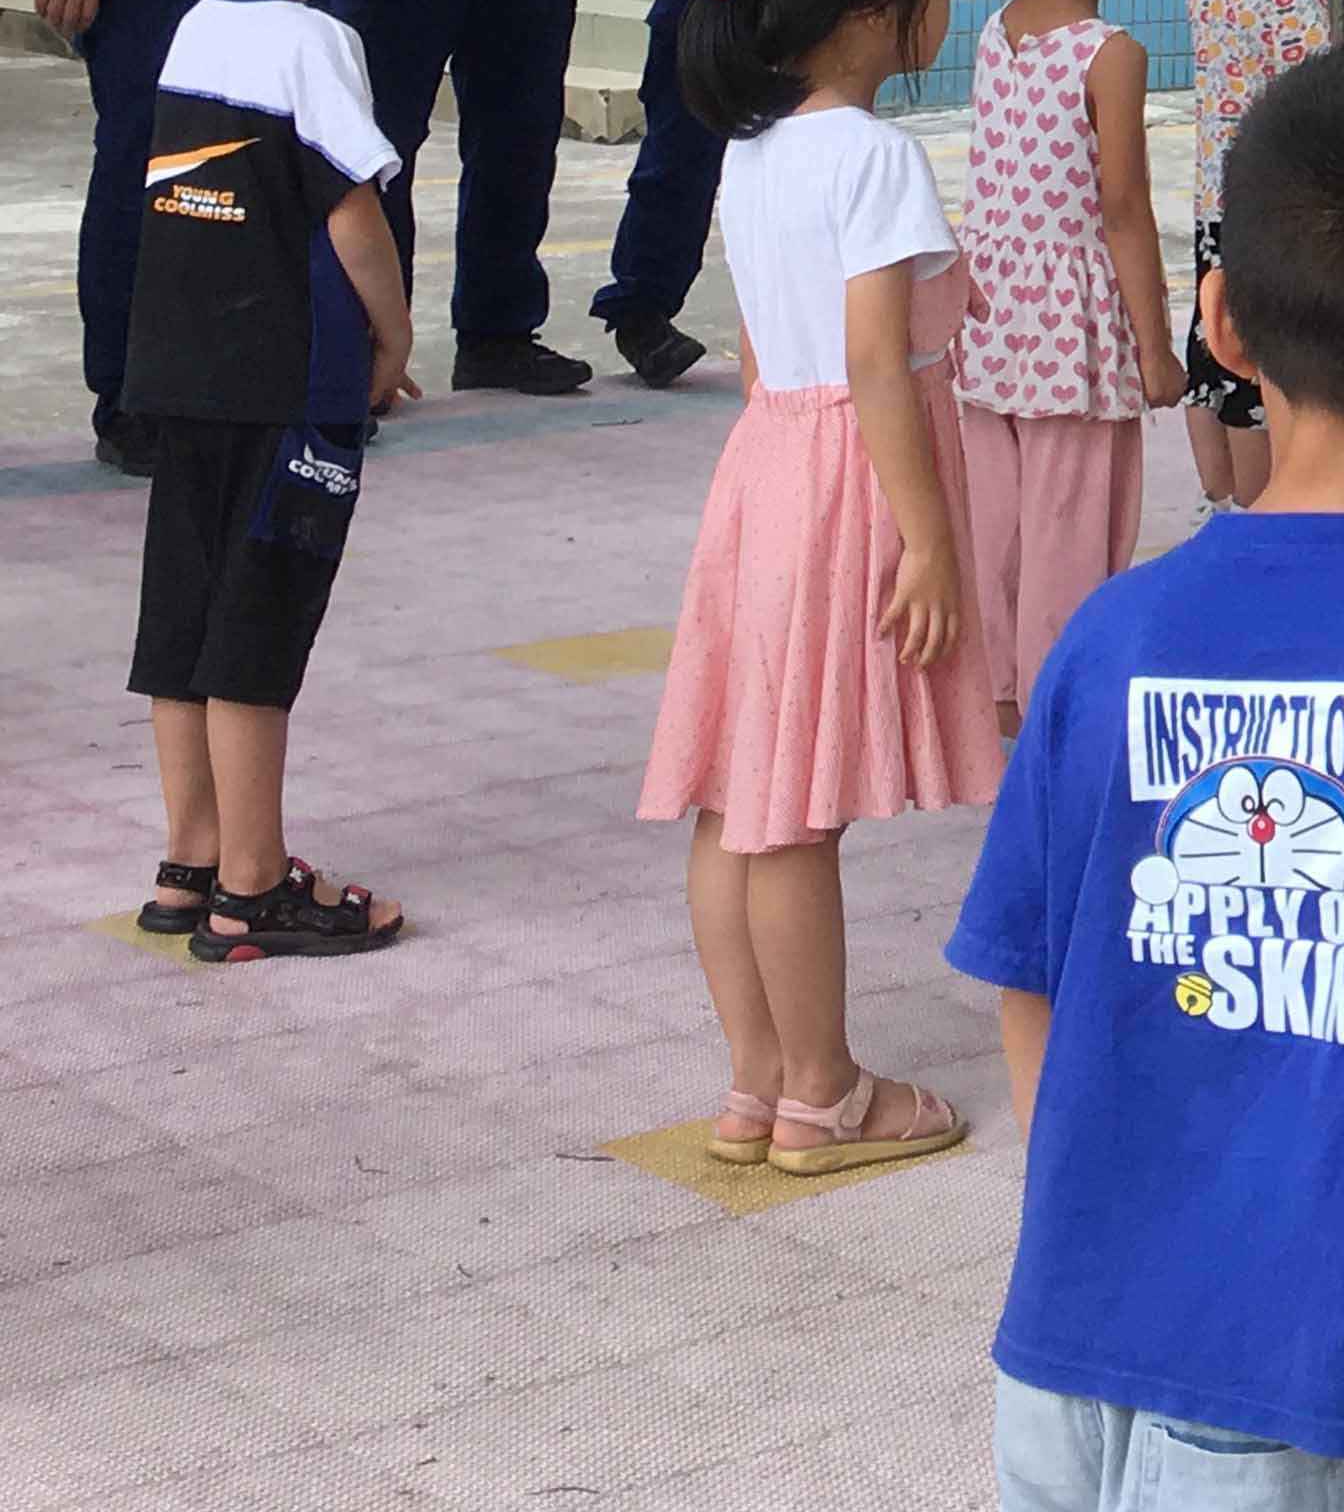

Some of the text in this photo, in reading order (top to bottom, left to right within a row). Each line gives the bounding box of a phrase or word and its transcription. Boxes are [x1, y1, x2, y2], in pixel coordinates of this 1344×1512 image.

[153, 196, 246, 223] COOLMISS
[172, 184, 235, 206] YOUNG
[1127, 882, 1306, 940] APPLY
[1126, 930, 1196, 965] THE
